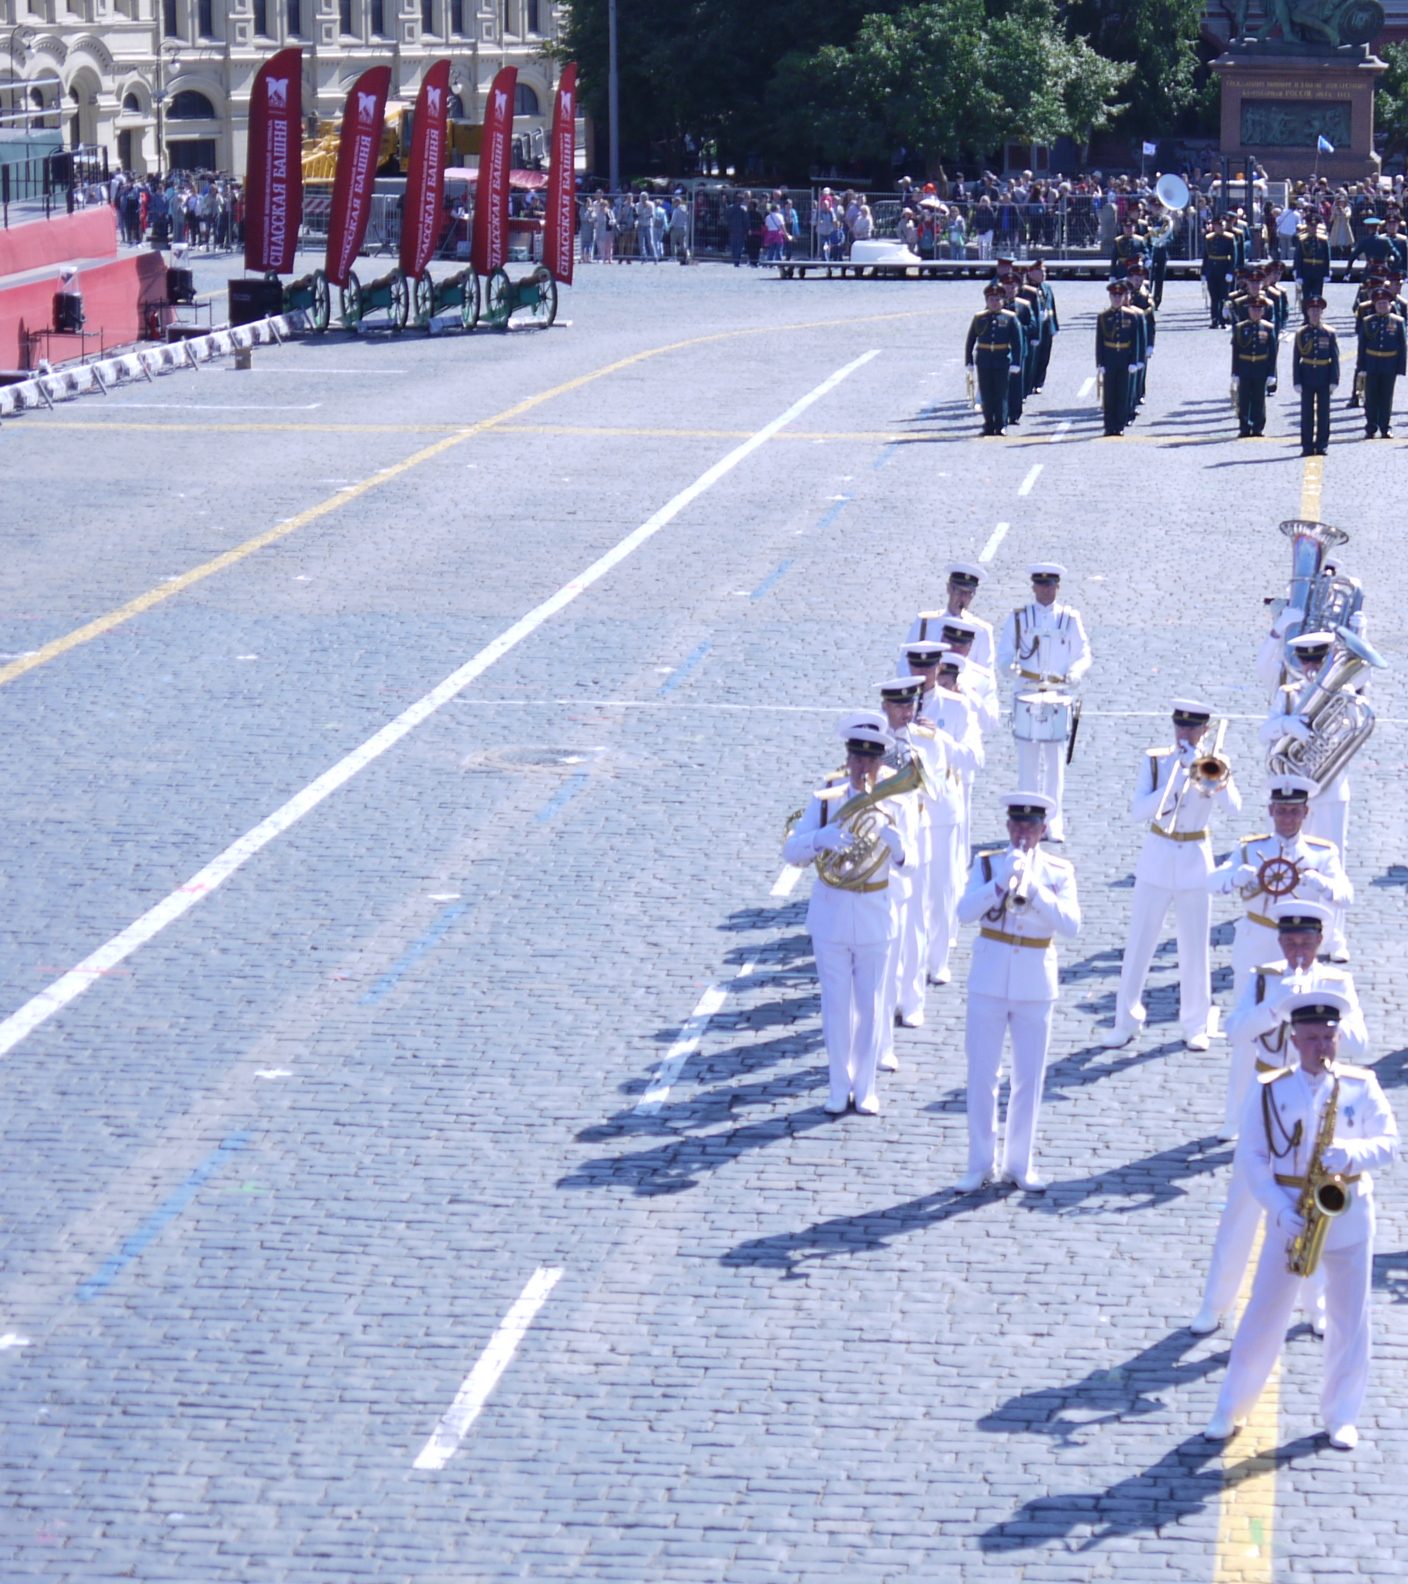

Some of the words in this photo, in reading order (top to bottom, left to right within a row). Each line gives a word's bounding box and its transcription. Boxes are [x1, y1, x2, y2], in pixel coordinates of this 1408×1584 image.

[273, 119, 287, 178] БАШНЯ
[354, 135, 372, 193] БАШНЯ
[427, 128, 439, 187] БАШНЯ
[492, 133, 503, 190] БАШНЯ
[562, 133, 571, 190] БАШНЯ
[269, 184, 286, 266] СПАССКАЯ
[560, 195, 570, 275] СПАССКАЯ
